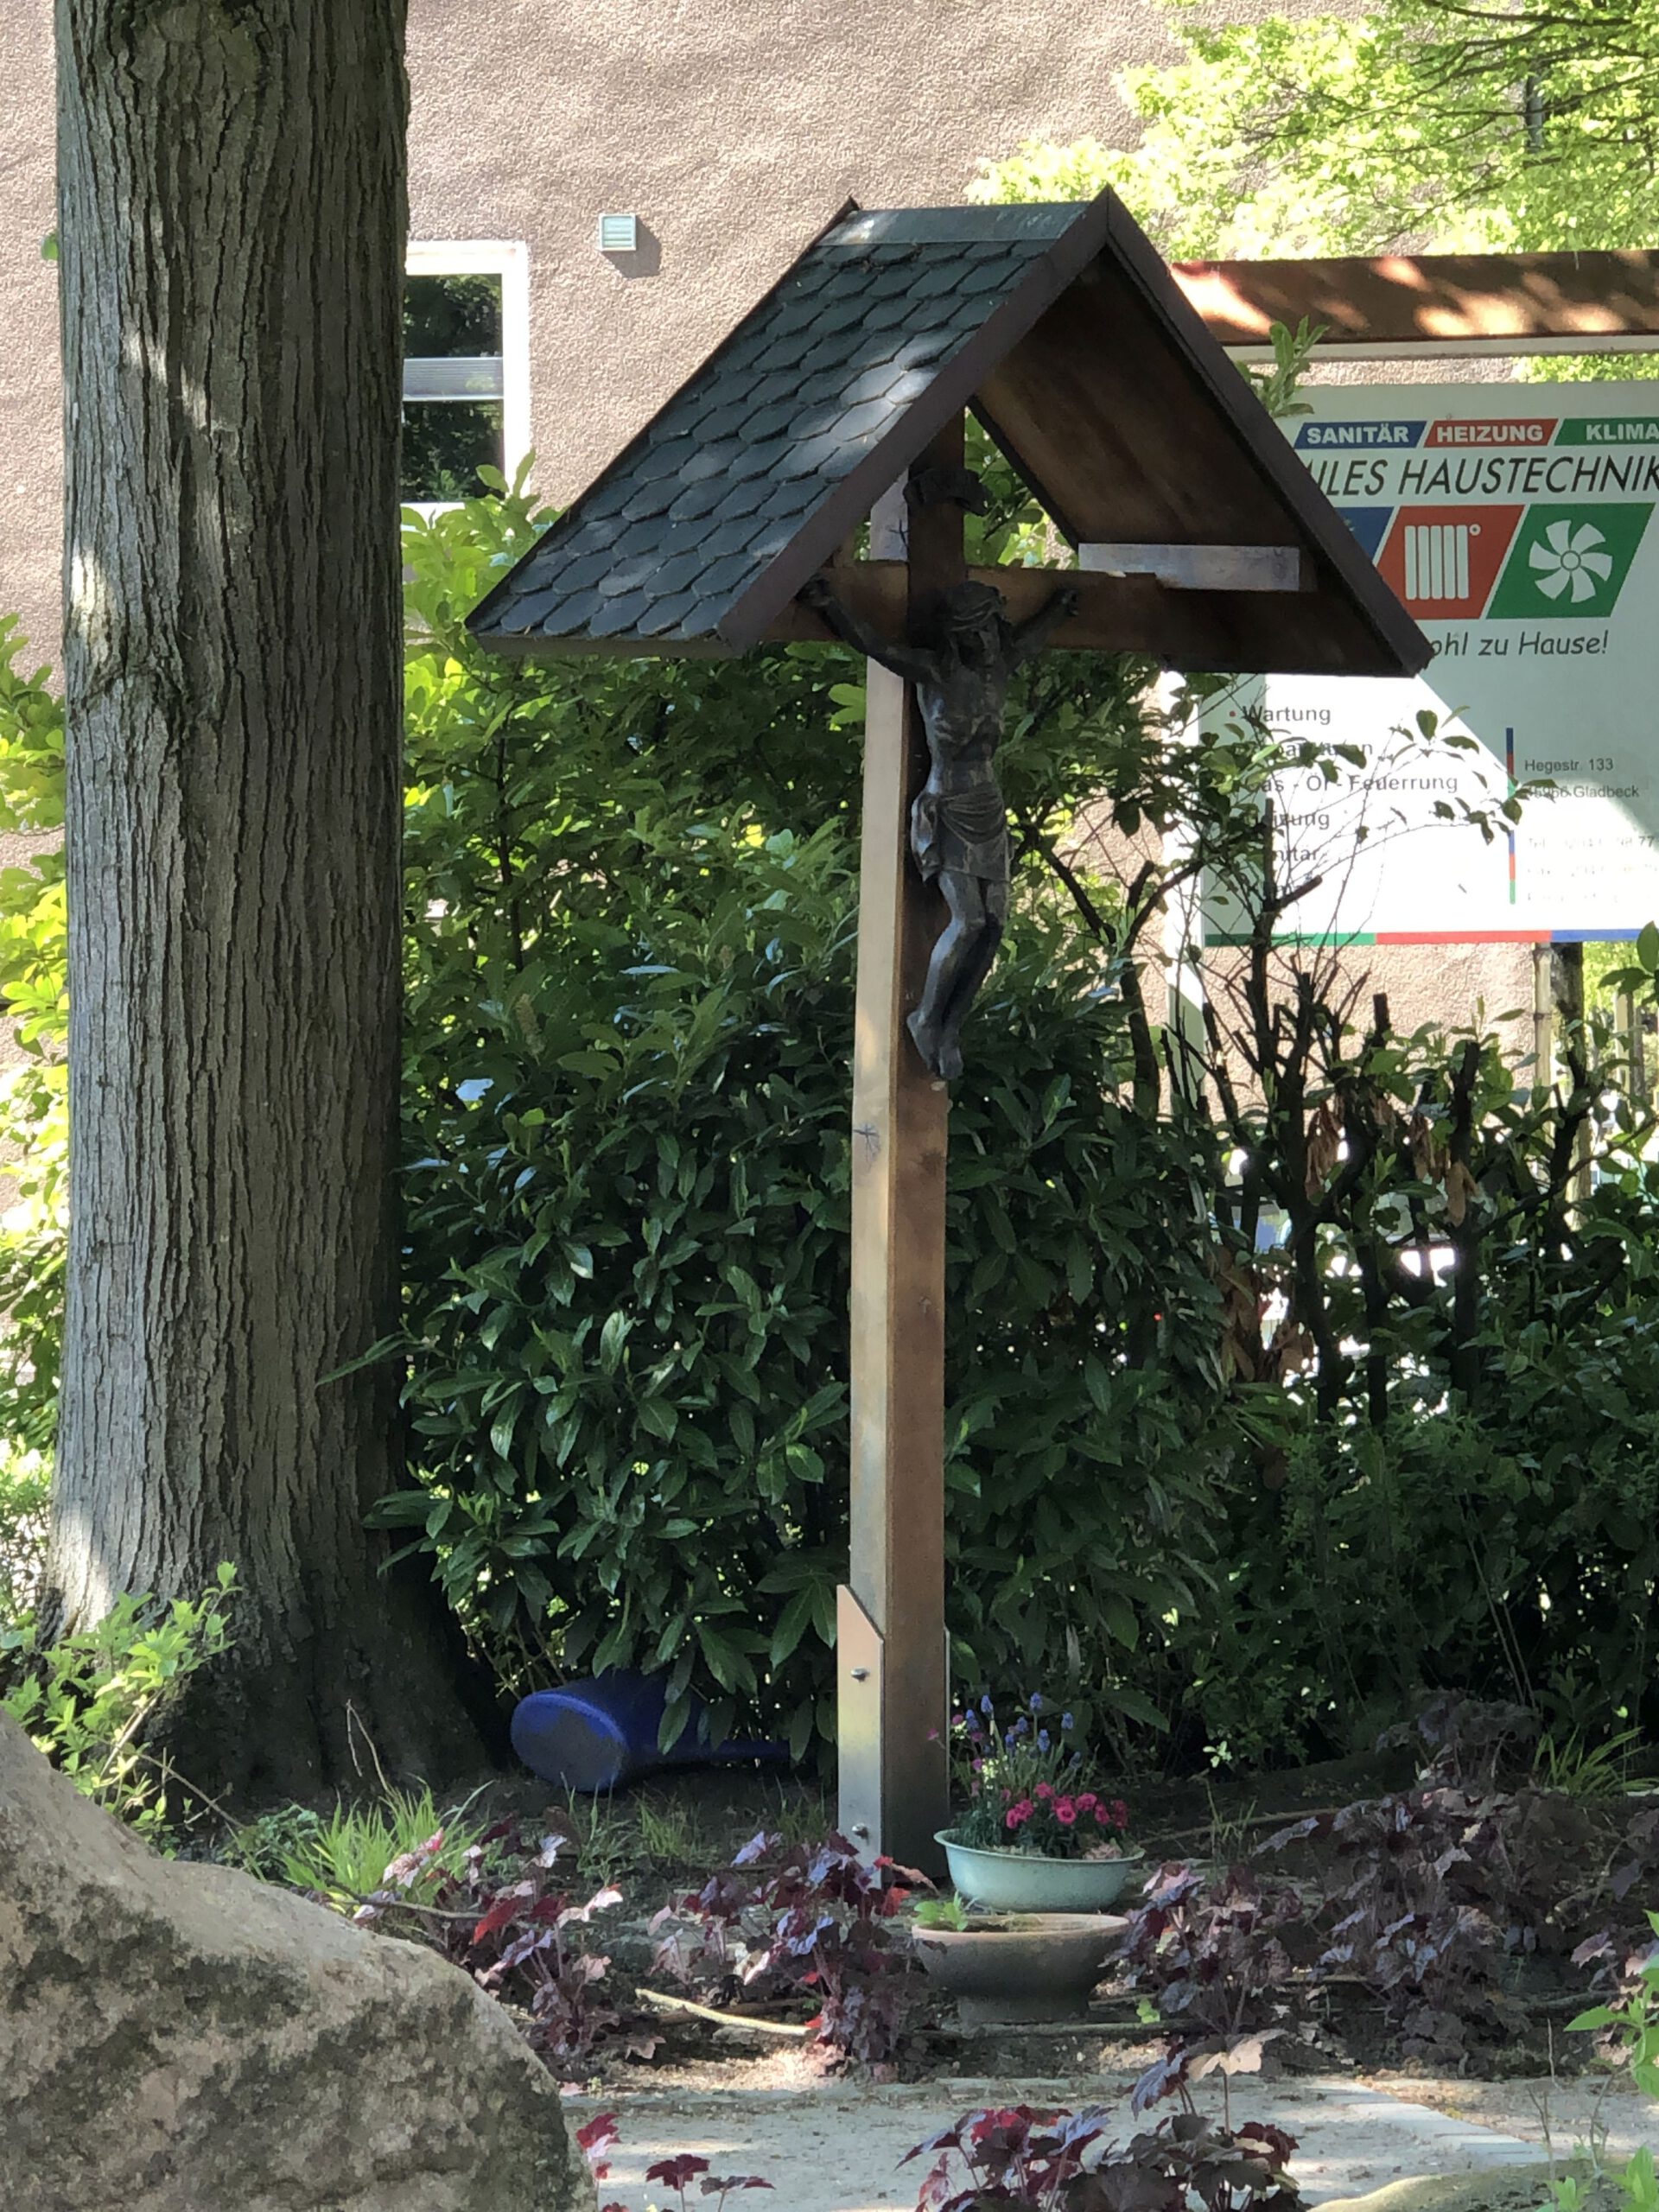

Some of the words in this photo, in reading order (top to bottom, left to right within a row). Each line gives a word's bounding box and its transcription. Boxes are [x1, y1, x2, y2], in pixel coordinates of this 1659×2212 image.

[1306, 423, 1409, 444] SANITÄR
[1436, 423, 1543, 442] HEIZUNG
[1586, 423, 1659, 442] KLIMA
[1306, 458, 1389, 496] ILES
[1398, 454, 1659, 495] HAUSTECHNIK
[1431, 632, 1468, 656] ohl
[1478, 639, 1509, 656] zu
[1518, 630, 1609, 655] Hause!
[1589, 758, 1614, 771] 133
[1348, 773, 1458, 793] Feuerrung
[1573, 785, 1640, 798] Gladbeck
[1272, 810, 1330, 830] izung
